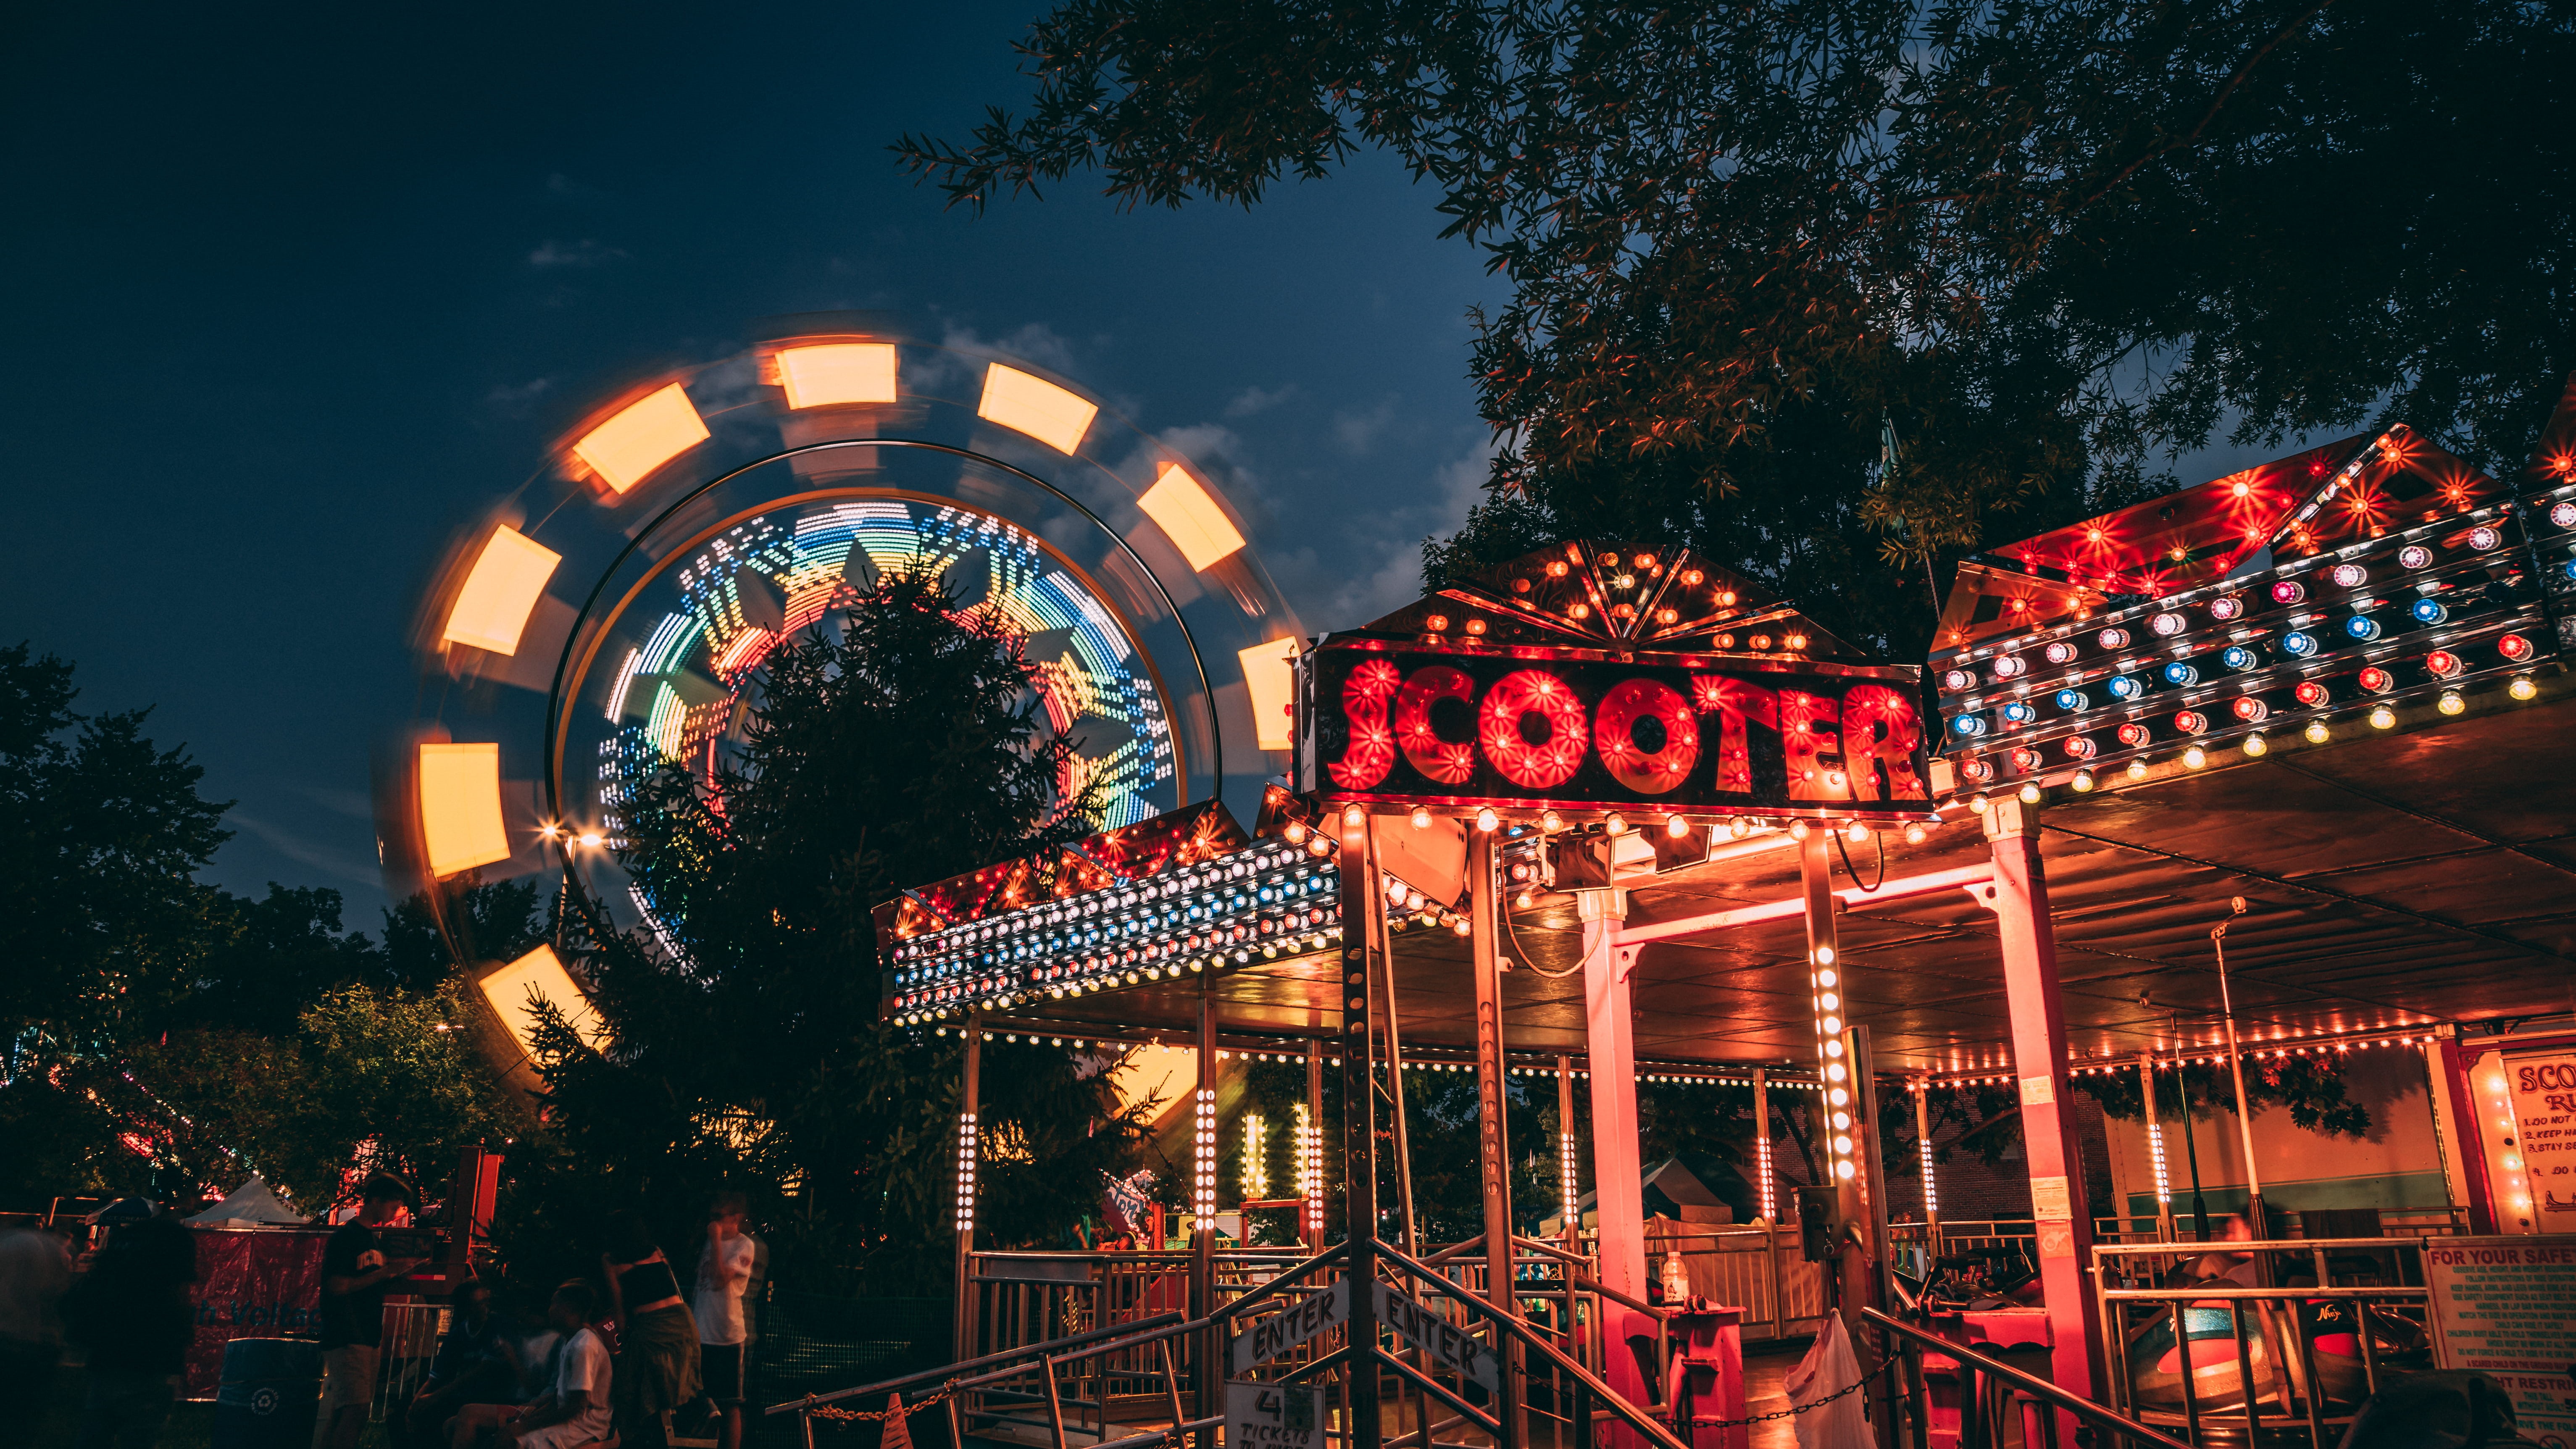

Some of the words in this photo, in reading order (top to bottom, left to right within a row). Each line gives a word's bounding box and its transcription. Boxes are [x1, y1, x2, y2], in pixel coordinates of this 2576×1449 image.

[1327, 658, 1929, 802] SCOOTER
[2551, 1115, 2571, 1124] NOT
[2552, 1166, 2568, 1175] DO
[2431, 1250, 2466, 1265] FOR
[2468, 1249, 2520, 1265] YOUR
[2524, 1249, 2576, 1264] SAFE
[231, 1300, 325, 1333] Voltag
[2316, 1304, 2342, 1321] Ninja
[1252, 1291, 1335, 1361] ENTER
[1386, 1291, 1477, 1375] ENTER
[1255, 1390, 1281, 1422] 4
[1241, 1423, 1310, 1444] TICKETS
[2537, 1421, 2555, 1430] THE
